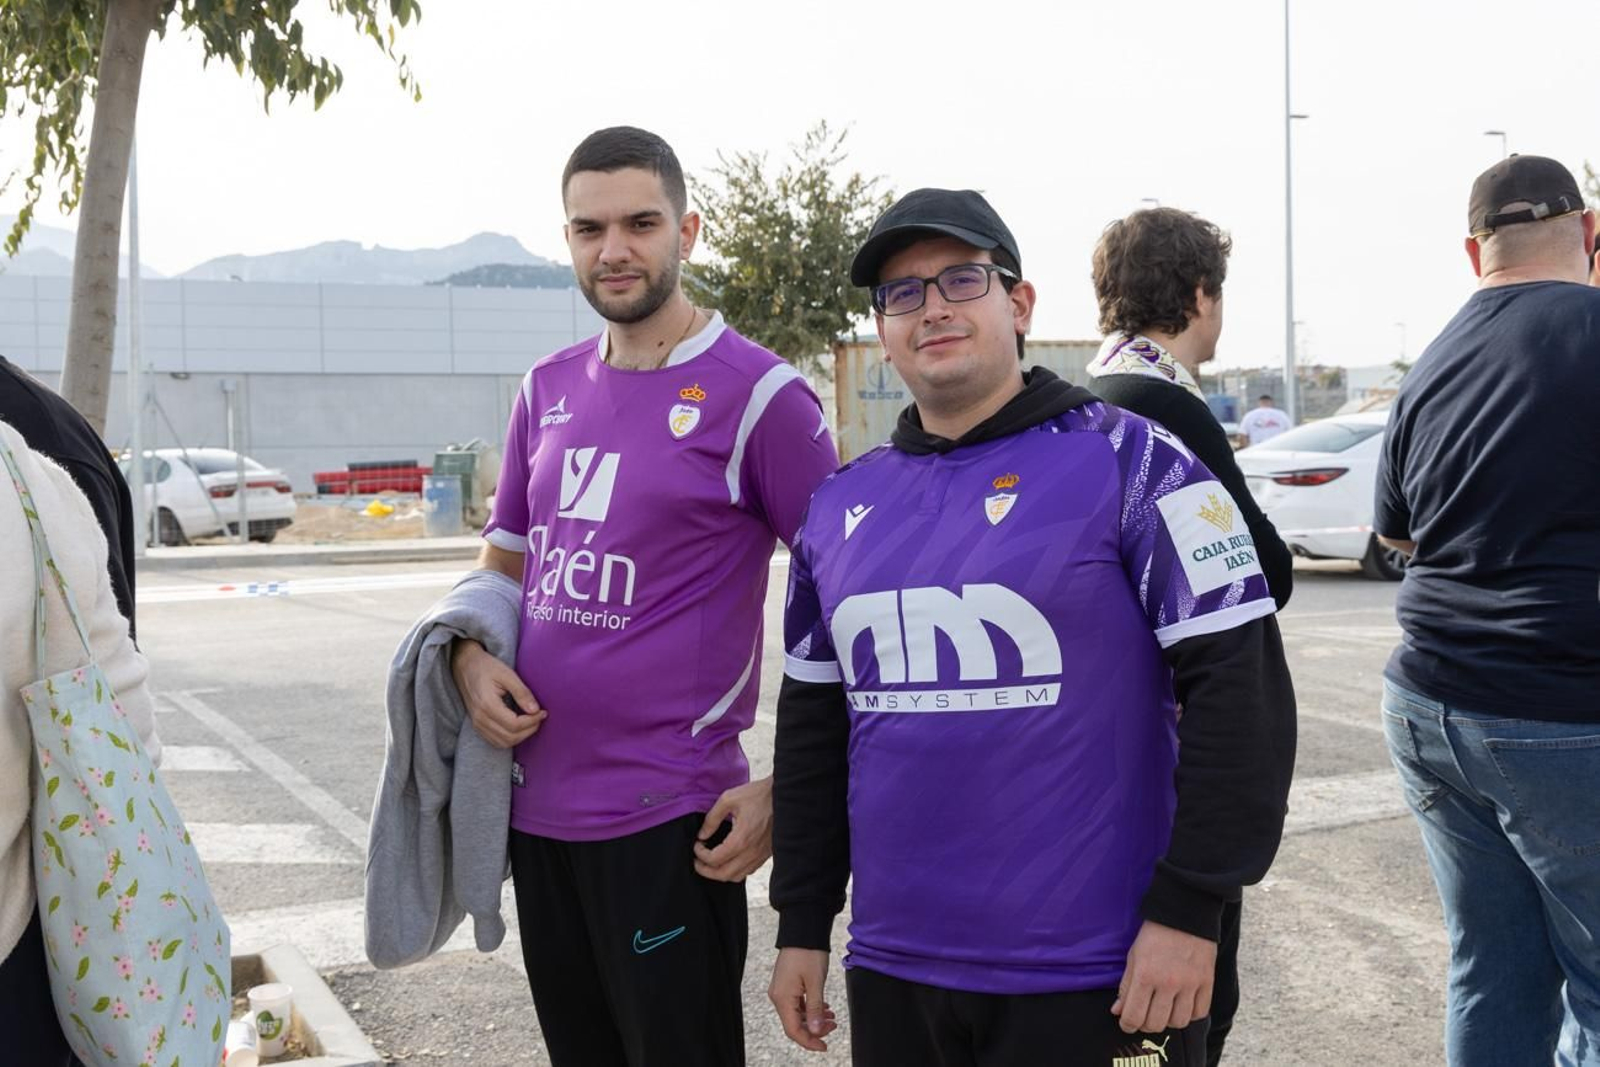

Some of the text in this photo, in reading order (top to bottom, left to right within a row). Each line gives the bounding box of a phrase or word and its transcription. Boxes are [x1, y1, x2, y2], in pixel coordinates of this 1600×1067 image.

[1192, 541, 1229, 562] CAJA
[1223, 550, 1255, 572] JAÉN
[557, 604, 631, 630] interior
